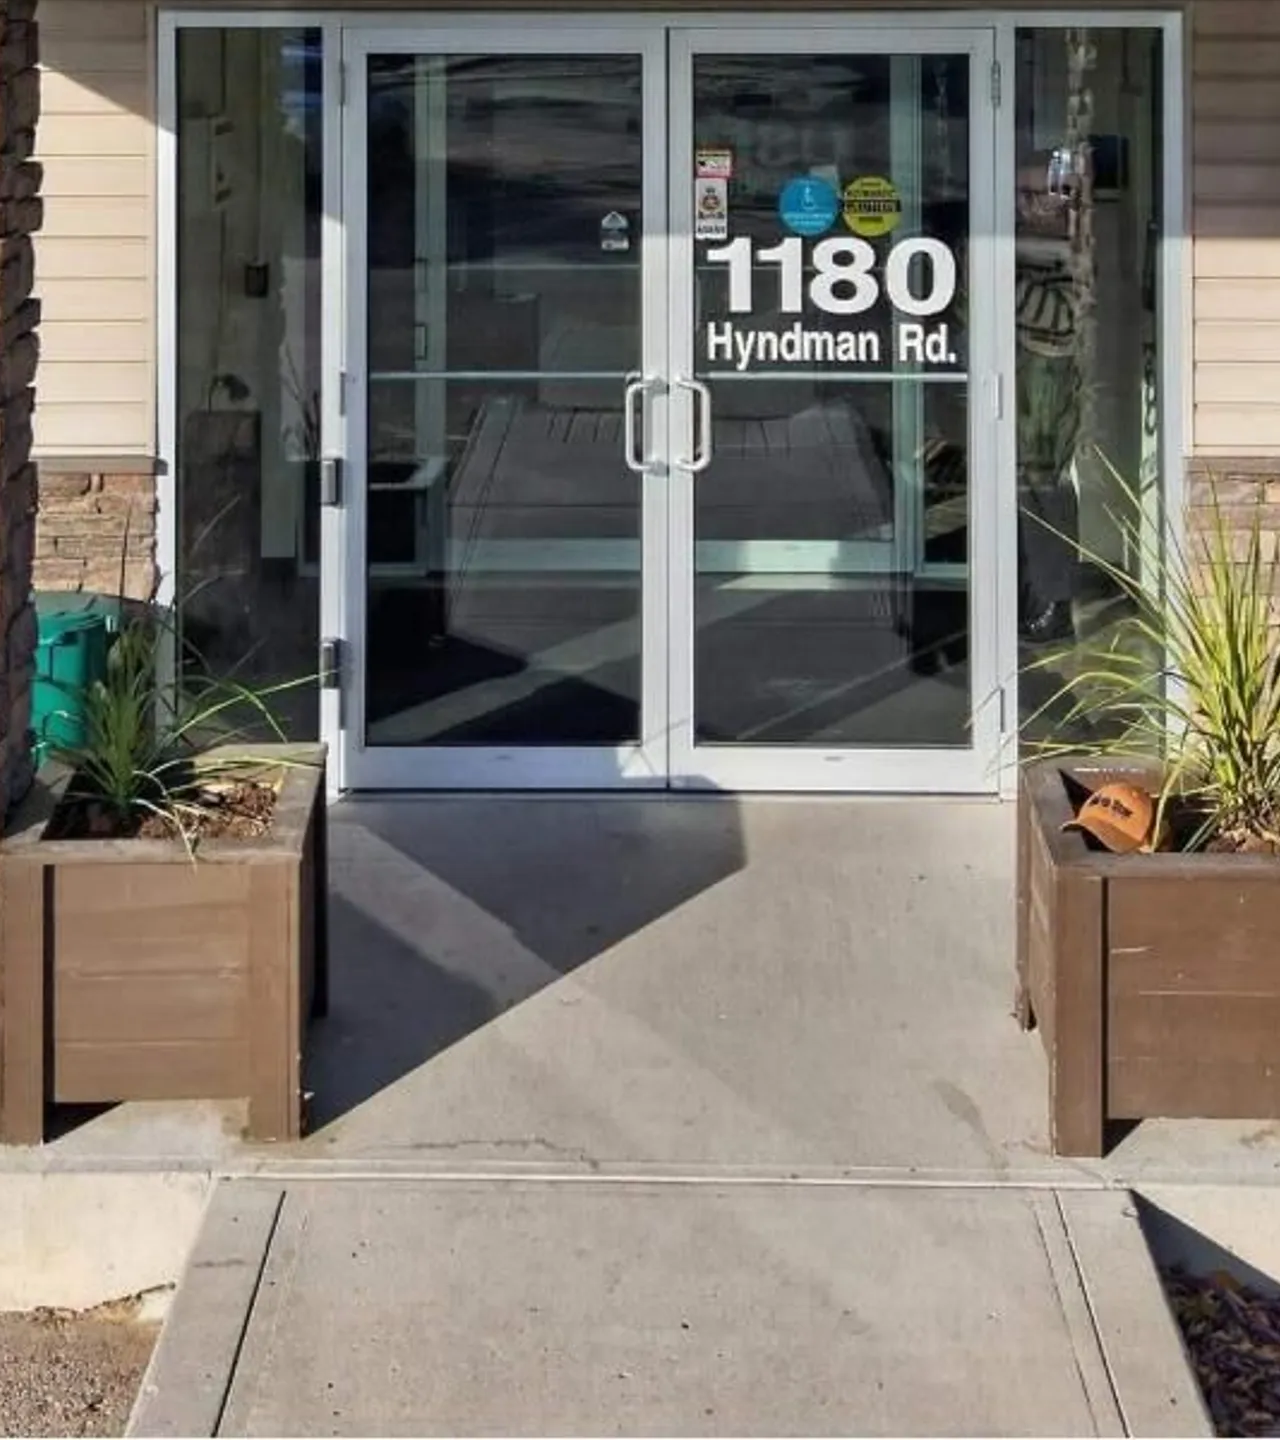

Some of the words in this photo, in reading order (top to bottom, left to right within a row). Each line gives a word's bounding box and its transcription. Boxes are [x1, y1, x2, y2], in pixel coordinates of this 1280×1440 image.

[707, 236, 957, 316] 1180
[707, 321, 879, 371] Hyndman
[899, 323, 956, 363] Rd.
